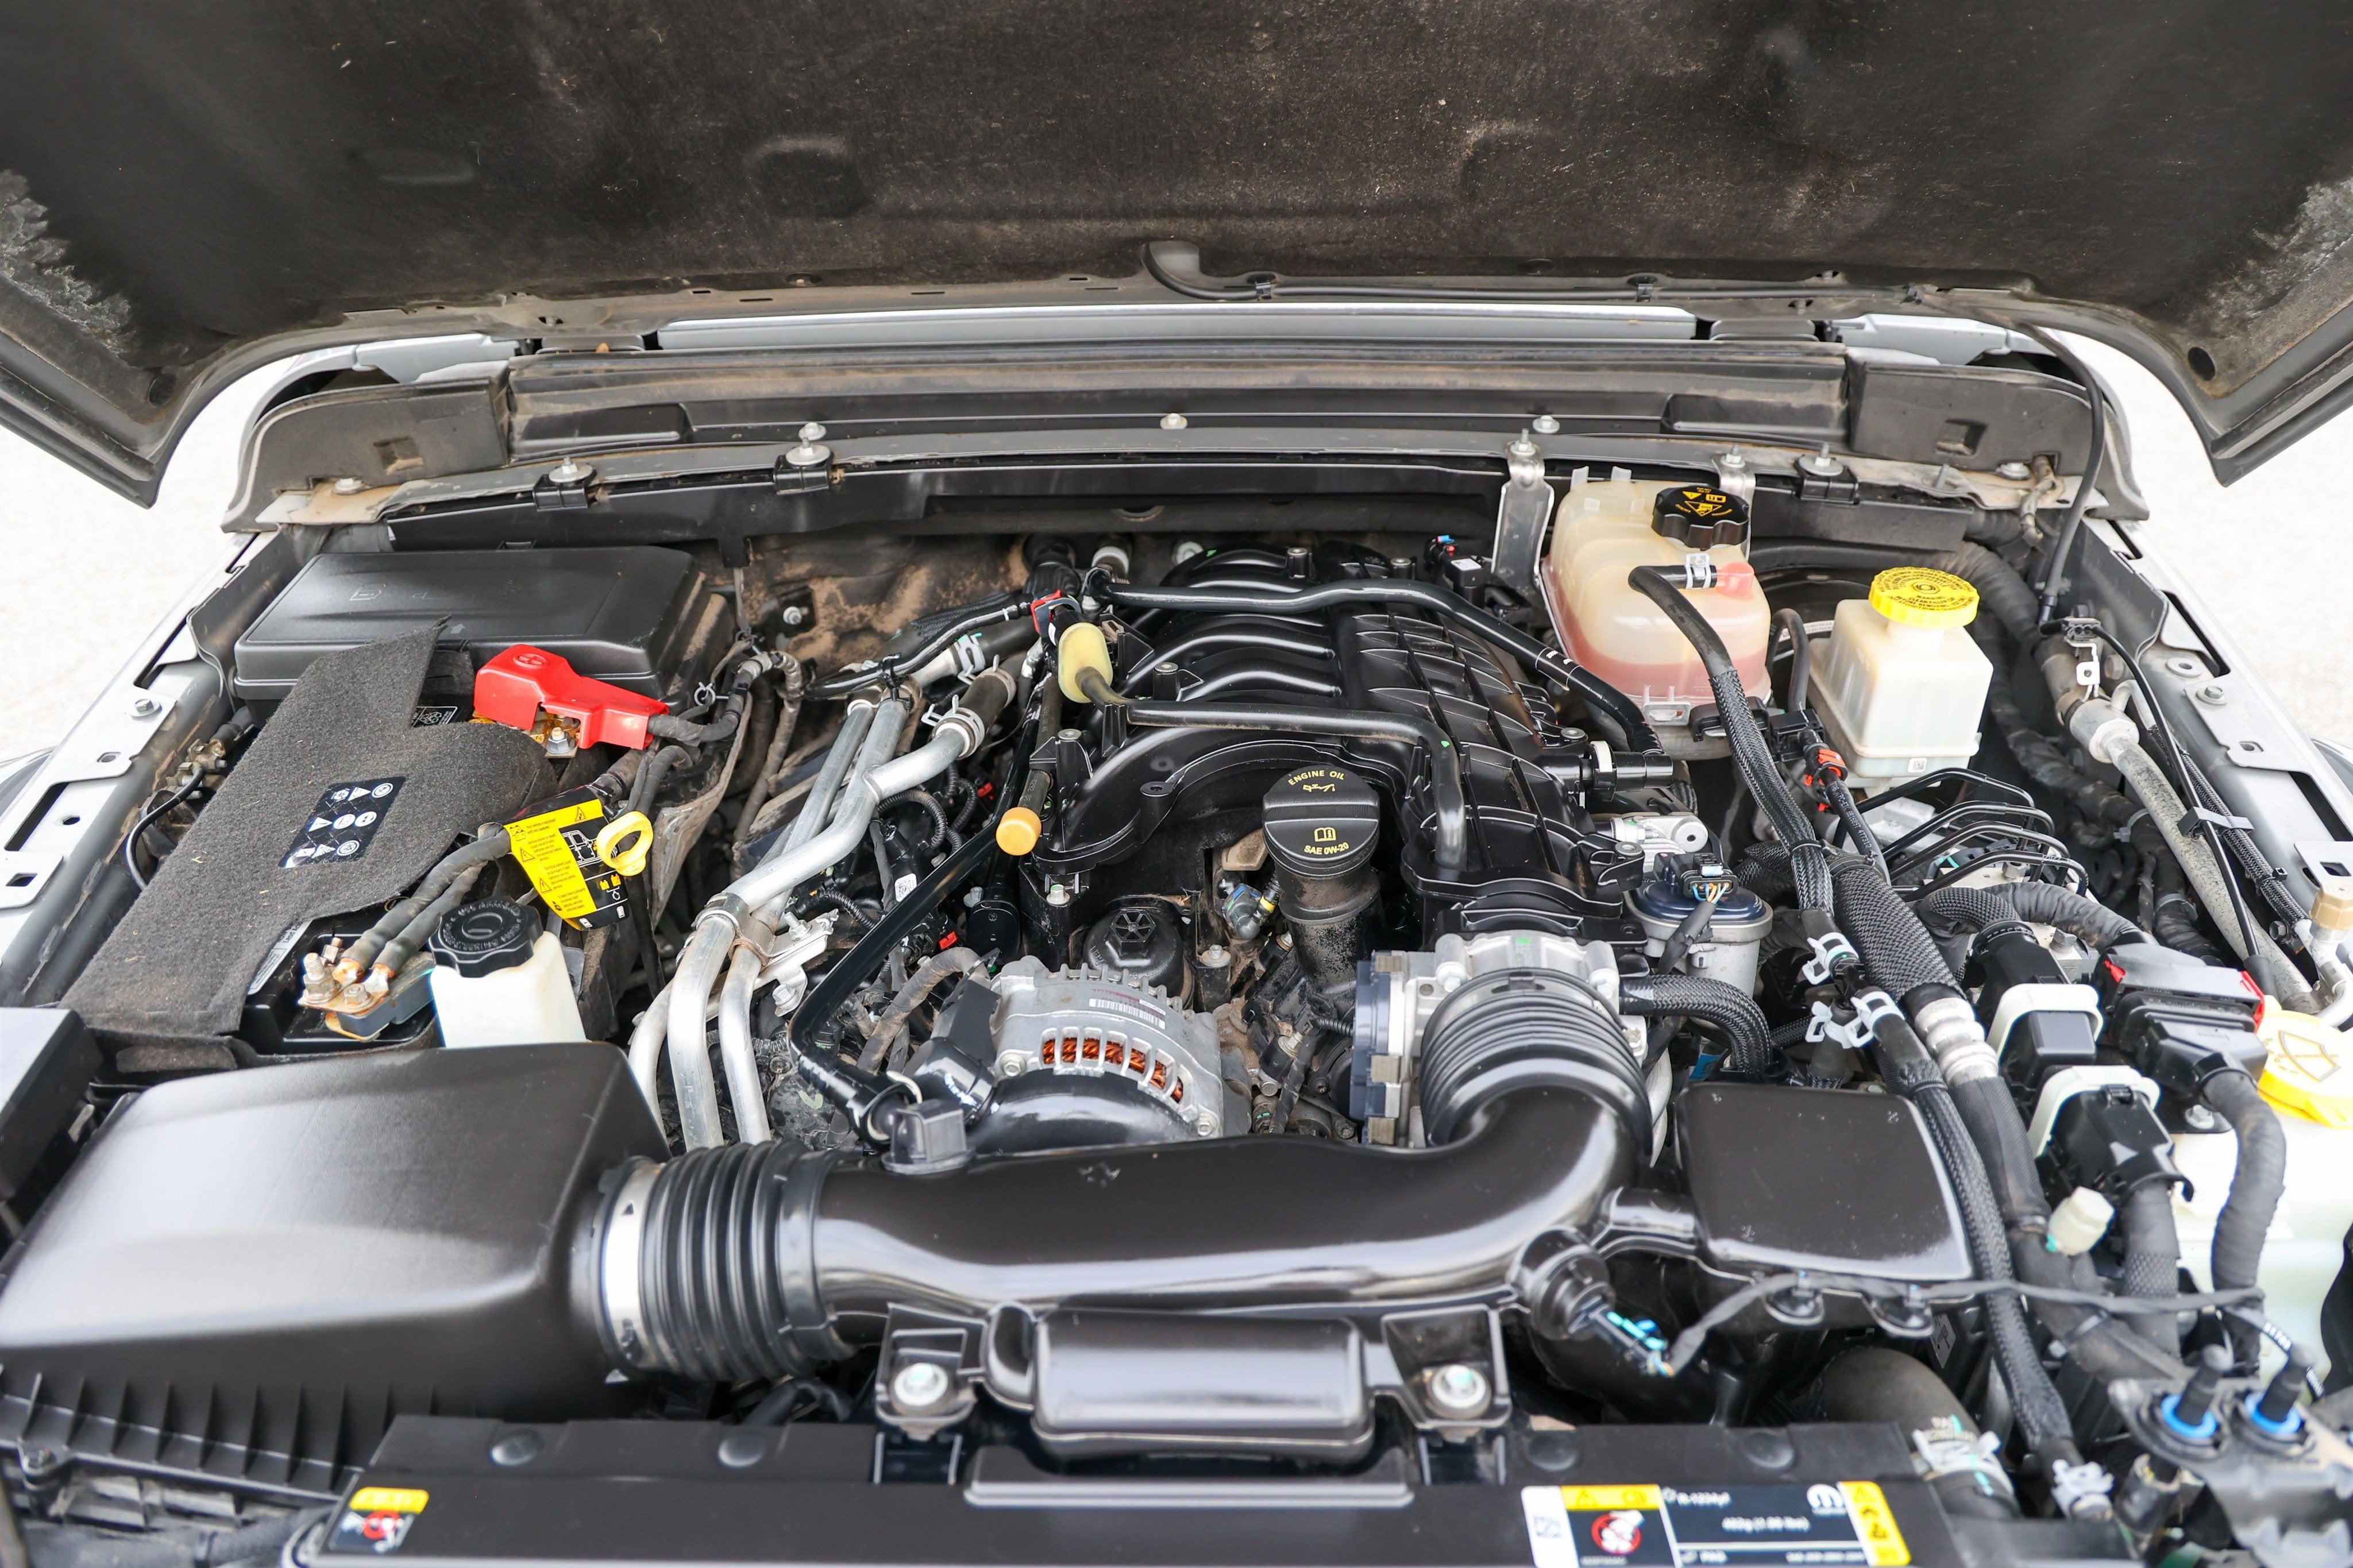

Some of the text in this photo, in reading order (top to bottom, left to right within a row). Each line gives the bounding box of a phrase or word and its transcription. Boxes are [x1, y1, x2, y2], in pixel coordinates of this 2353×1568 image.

[1288, 770, 1345, 786] ENGINE OIL
[1304, 842, 1349, 855] SAE 0W-20
